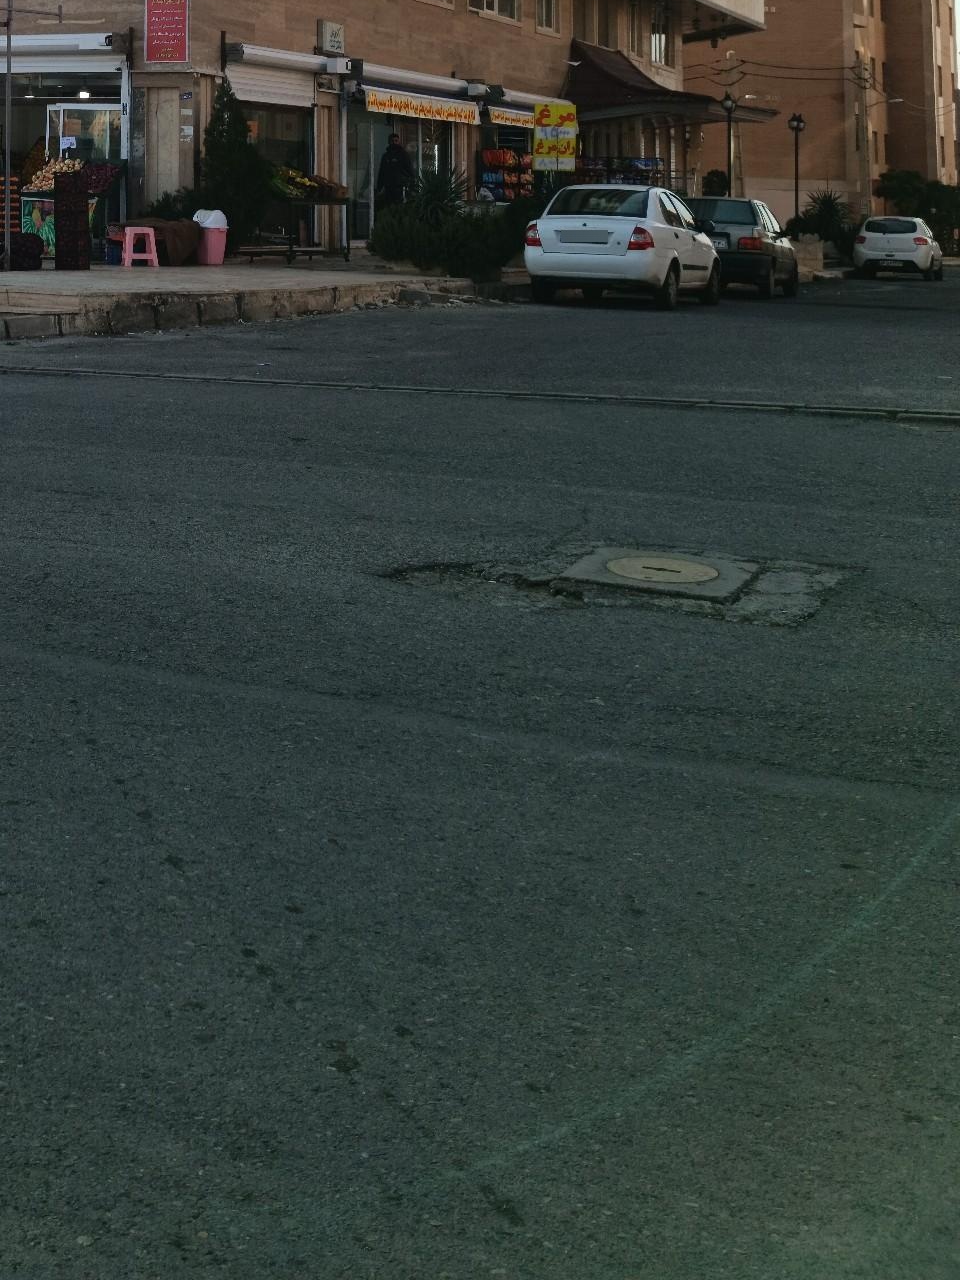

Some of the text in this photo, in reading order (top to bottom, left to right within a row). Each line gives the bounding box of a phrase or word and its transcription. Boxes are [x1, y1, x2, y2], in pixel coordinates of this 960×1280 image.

[535, 104, 576, 128] مرغ
[535, 139, 575, 156] ران مرغ
